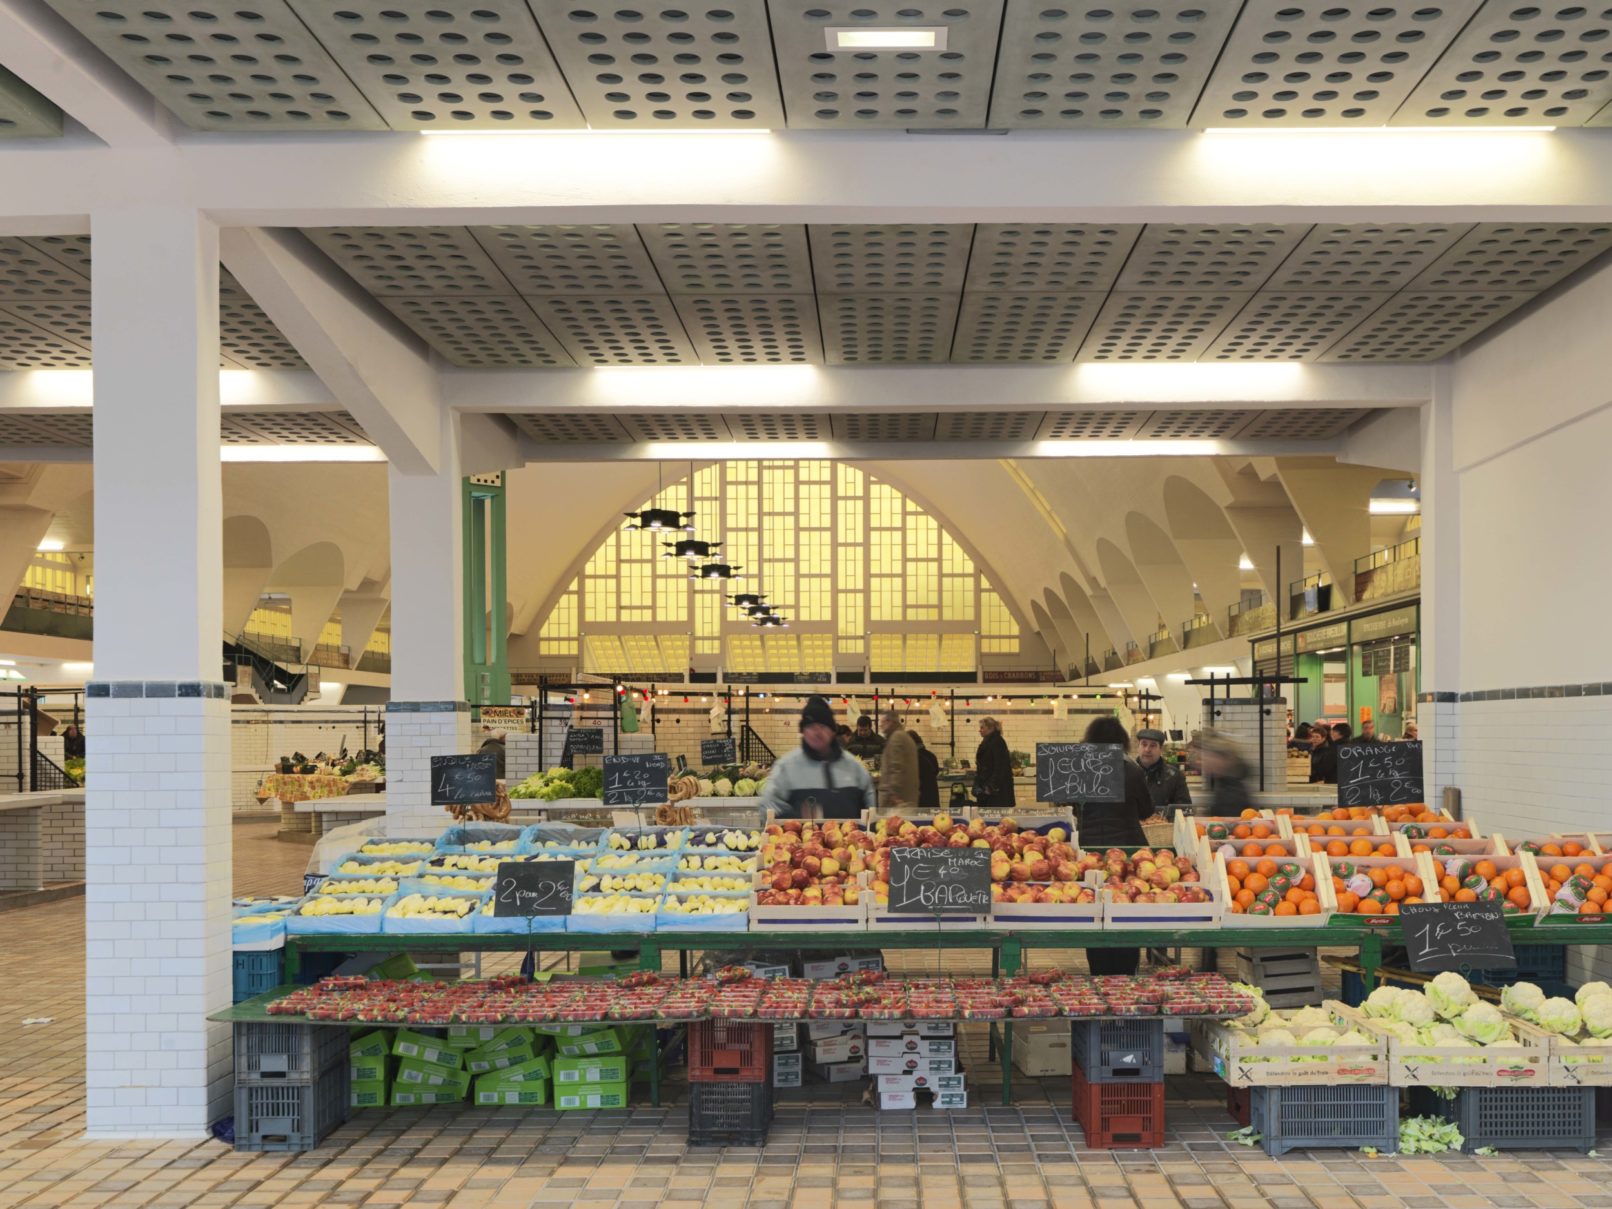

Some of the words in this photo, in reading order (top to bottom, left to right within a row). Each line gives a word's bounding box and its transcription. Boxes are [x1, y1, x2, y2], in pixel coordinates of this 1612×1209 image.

[608, 790, 619, 804] 2
[1345, 786, 1361, 805] 2
[948, 858, 985, 867] MAROC
